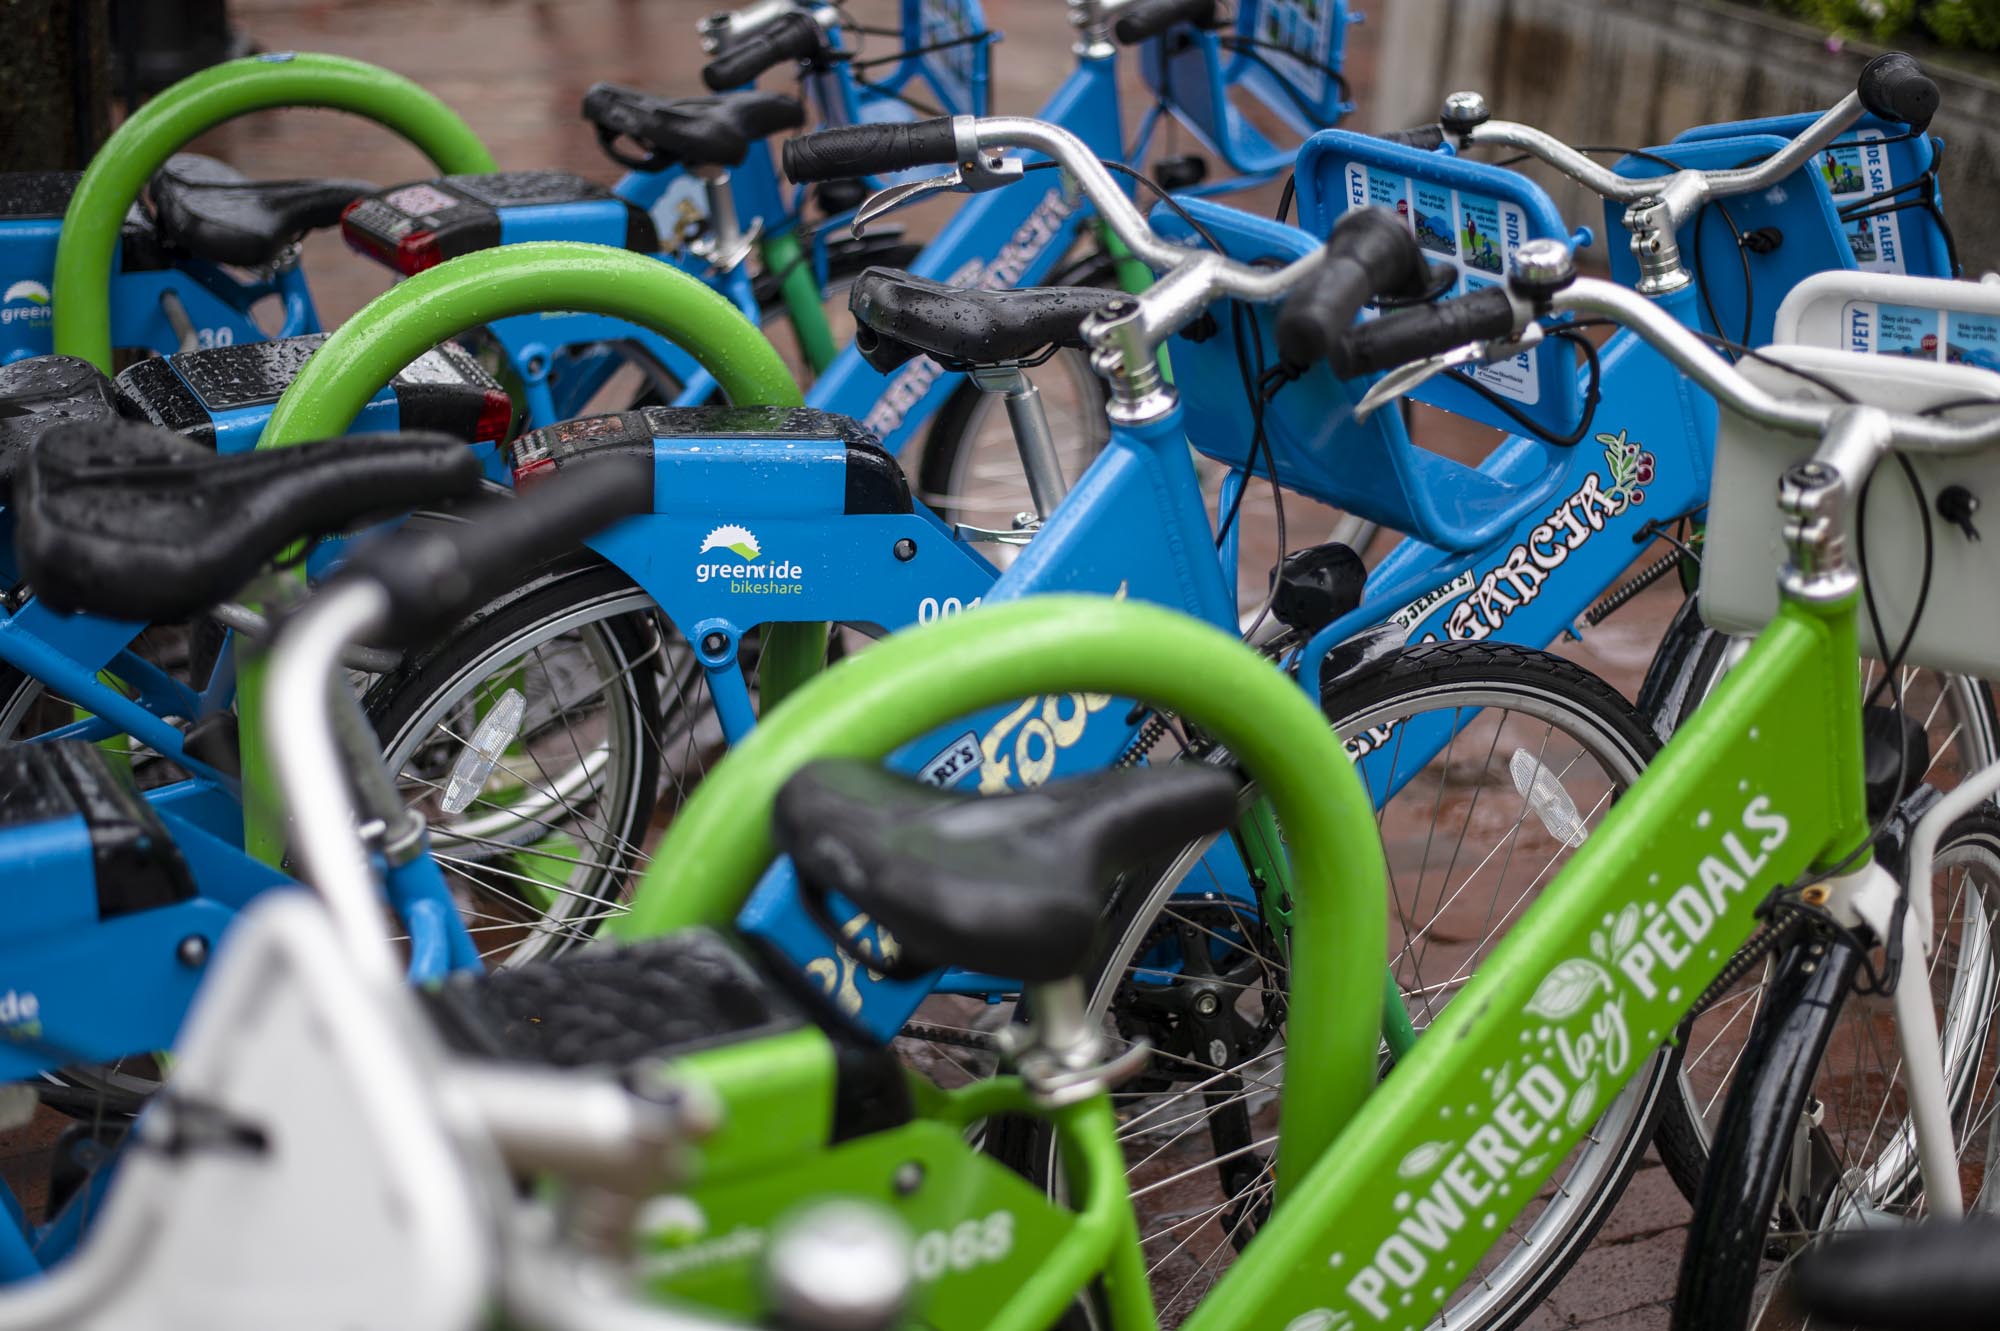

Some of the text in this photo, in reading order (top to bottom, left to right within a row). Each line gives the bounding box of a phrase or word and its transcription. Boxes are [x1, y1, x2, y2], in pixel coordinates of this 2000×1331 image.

[1505, 212, 1520, 249] RIDE
[1878, 226, 1896, 263] ALERT
[1443, 472, 1627, 643] GARCIA
[730, 580, 803, 595] bikeshare
[1407, 576, 1467, 619] JERRYS
[926, 745, 974, 785] RY'S
[1345, 795, 1791, 1322] POWERED by PEDALS
